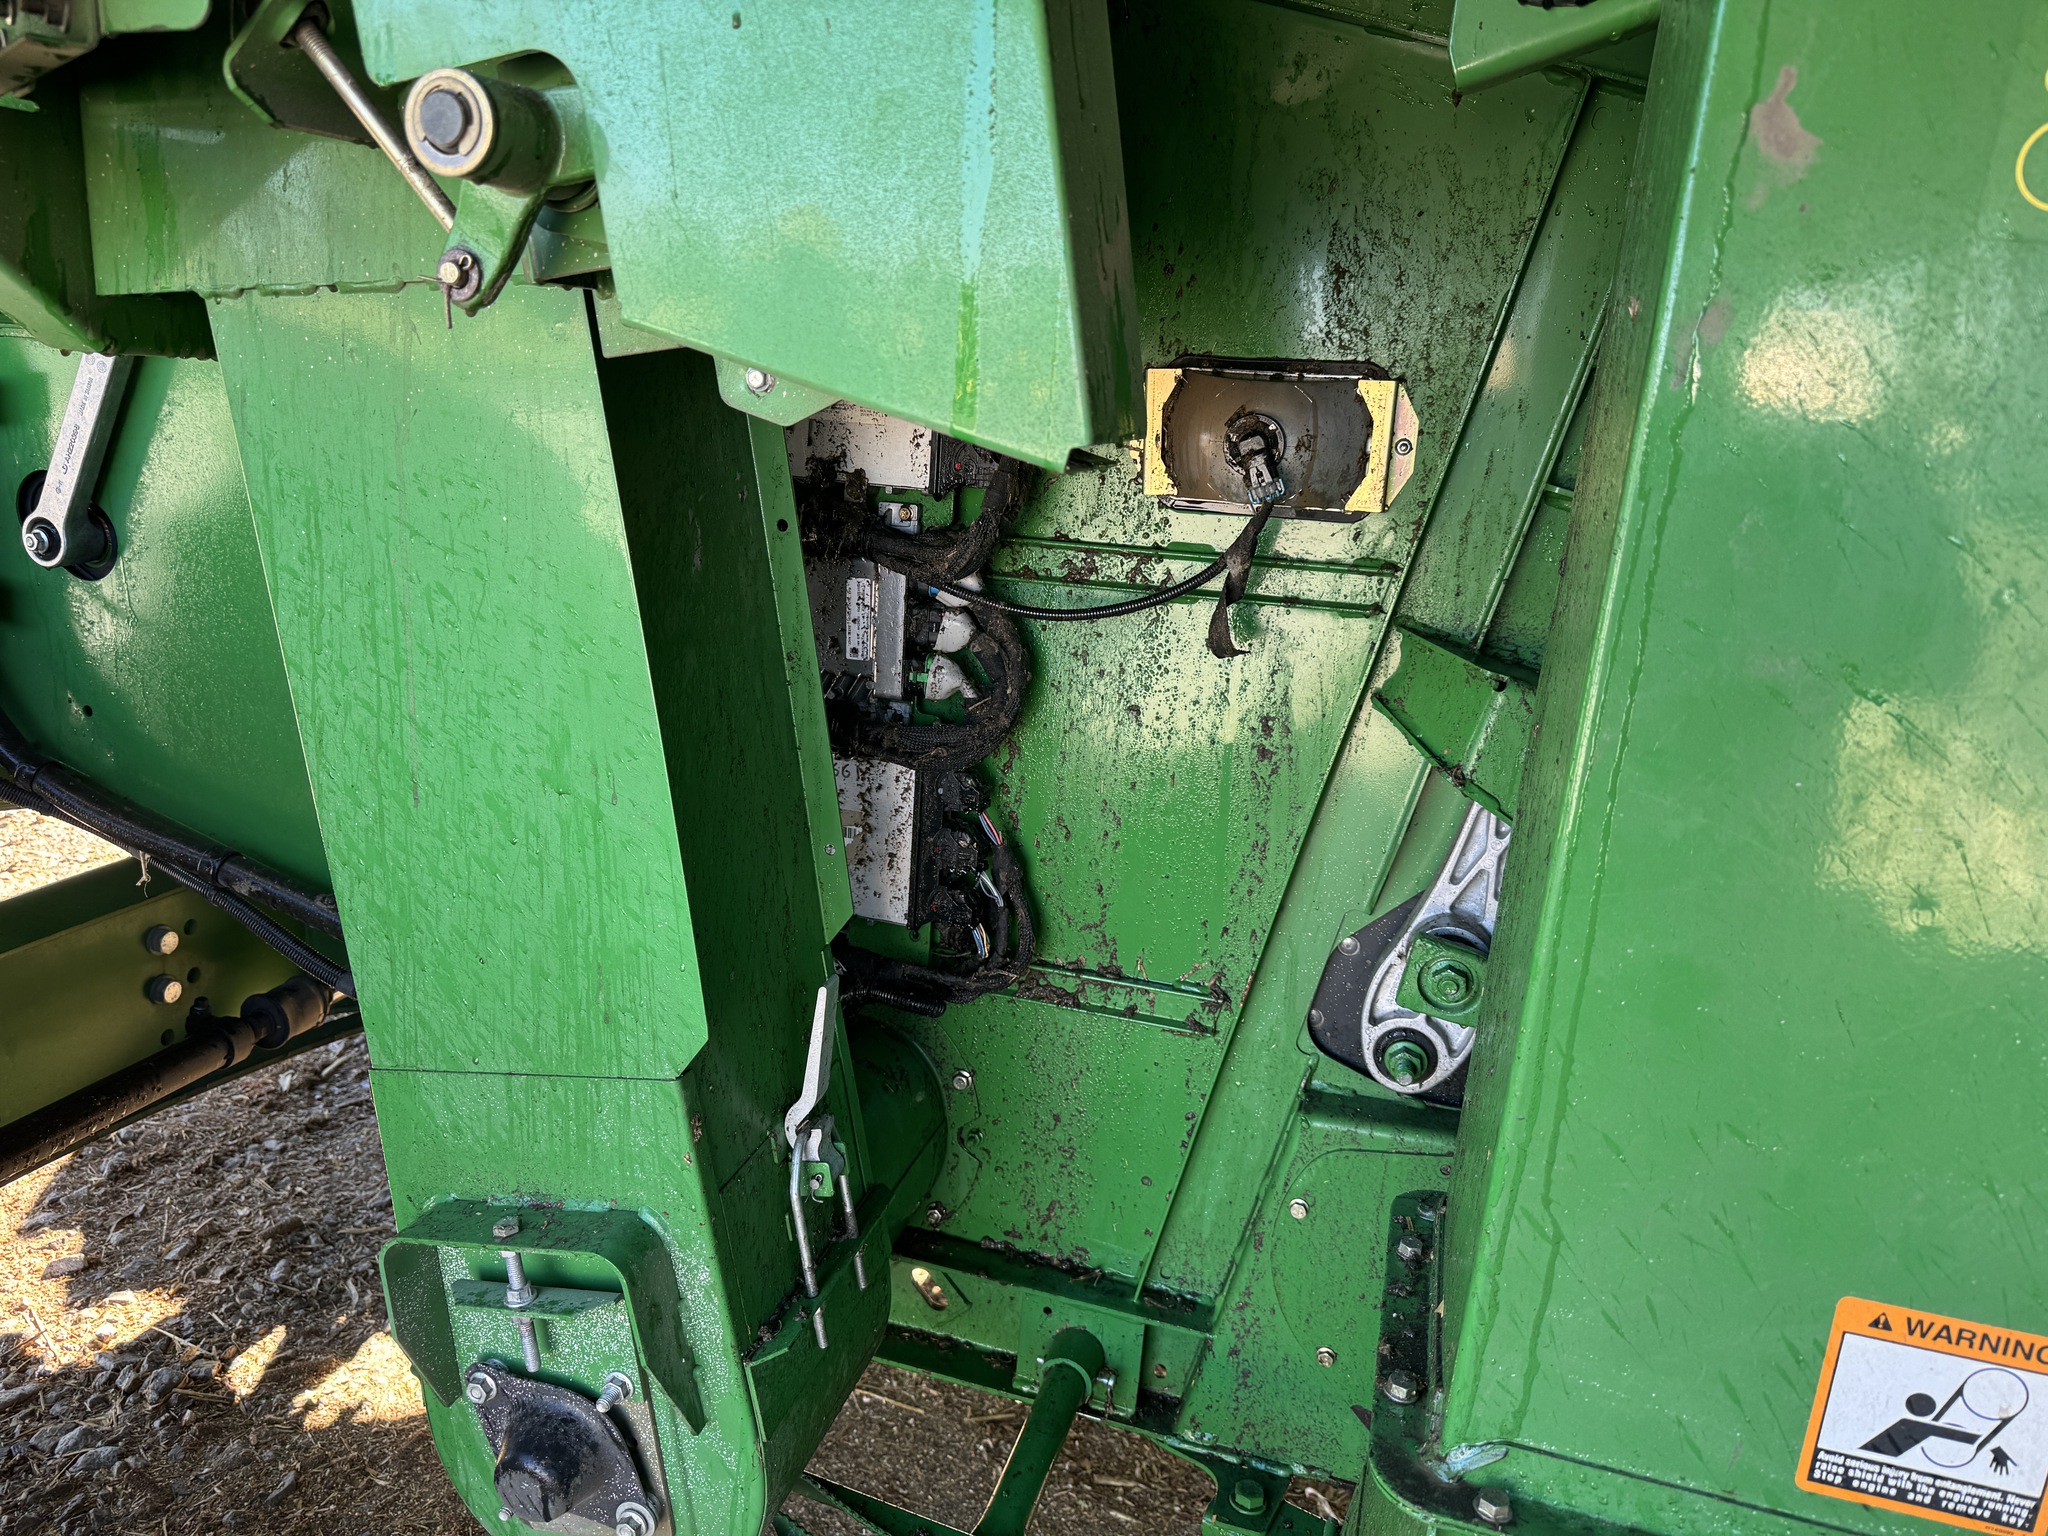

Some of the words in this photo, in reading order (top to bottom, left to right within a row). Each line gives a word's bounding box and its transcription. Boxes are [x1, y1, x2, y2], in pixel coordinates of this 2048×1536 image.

[1813, 1469, 1843, 1485] Stop
[1852, 1478, 1897, 1498] engine
[1906, 1491, 1932, 1505] and
[1941, 1499, 1991, 1519] remove
[1815, 1460, 1845, 1475] raise
[1848, 1467, 1885, 1484] shield
[1887, 1476, 1914, 1490] with
[1916, 1483, 1936, 1495] the
[1938, 1488, 1980, 1507] engine
[1817, 1450, 1845, 1465] Avoid
[1845, 1457, 1881, 1473] serious
[1910, 1471, 1935, 1486] from
[2006, 1493, 2037, 1509] Never
